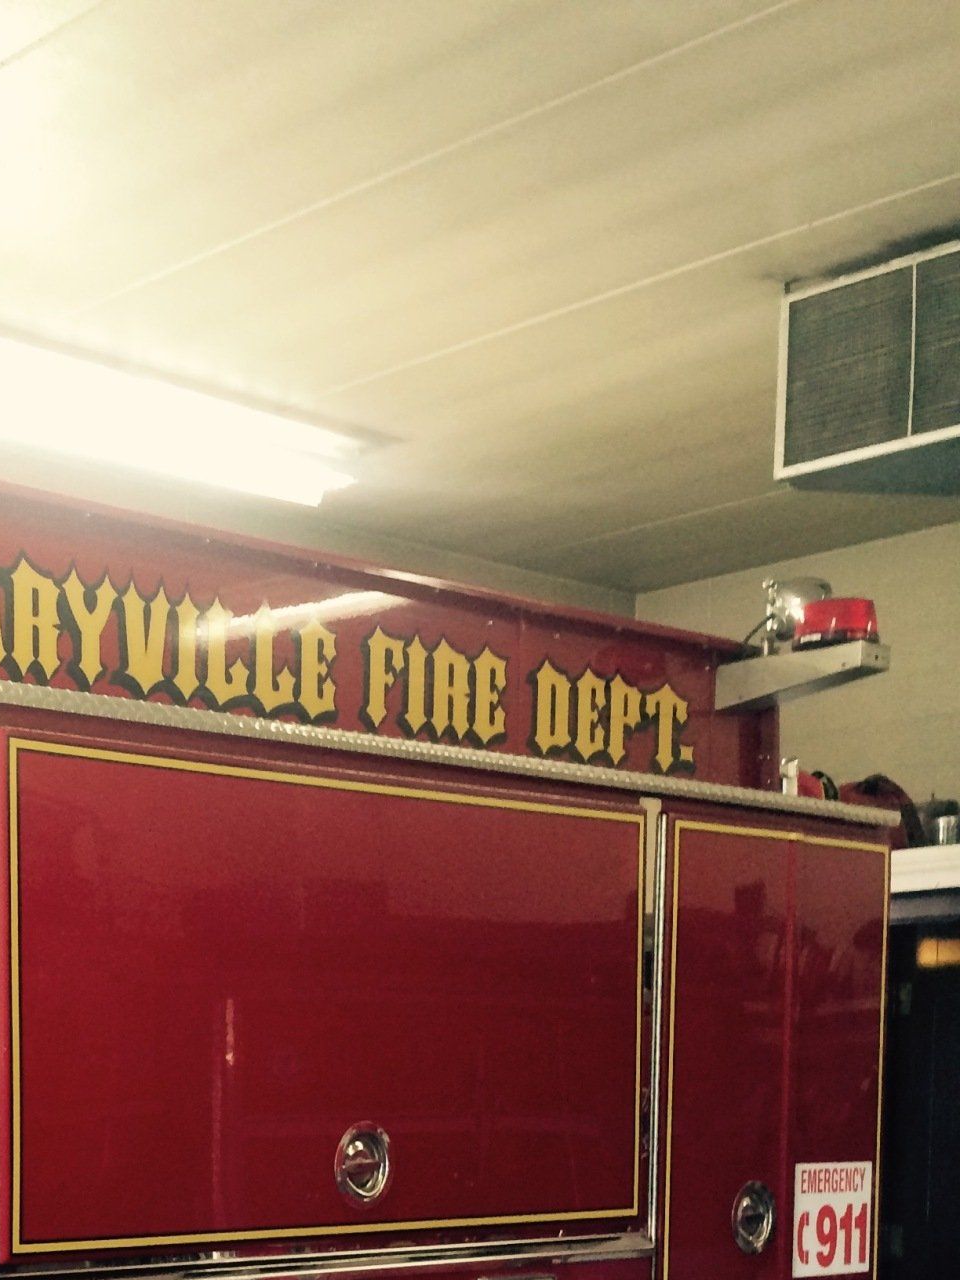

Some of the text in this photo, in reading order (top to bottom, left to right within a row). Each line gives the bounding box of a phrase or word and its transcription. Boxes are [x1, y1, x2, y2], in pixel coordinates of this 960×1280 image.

[360, 624, 508, 747] FIRE
[530, 658, 696, 774] DEPT.
[800, 1167, 866, 1194] EMERGENCY
[816, 1203, 868, 1268] 911
